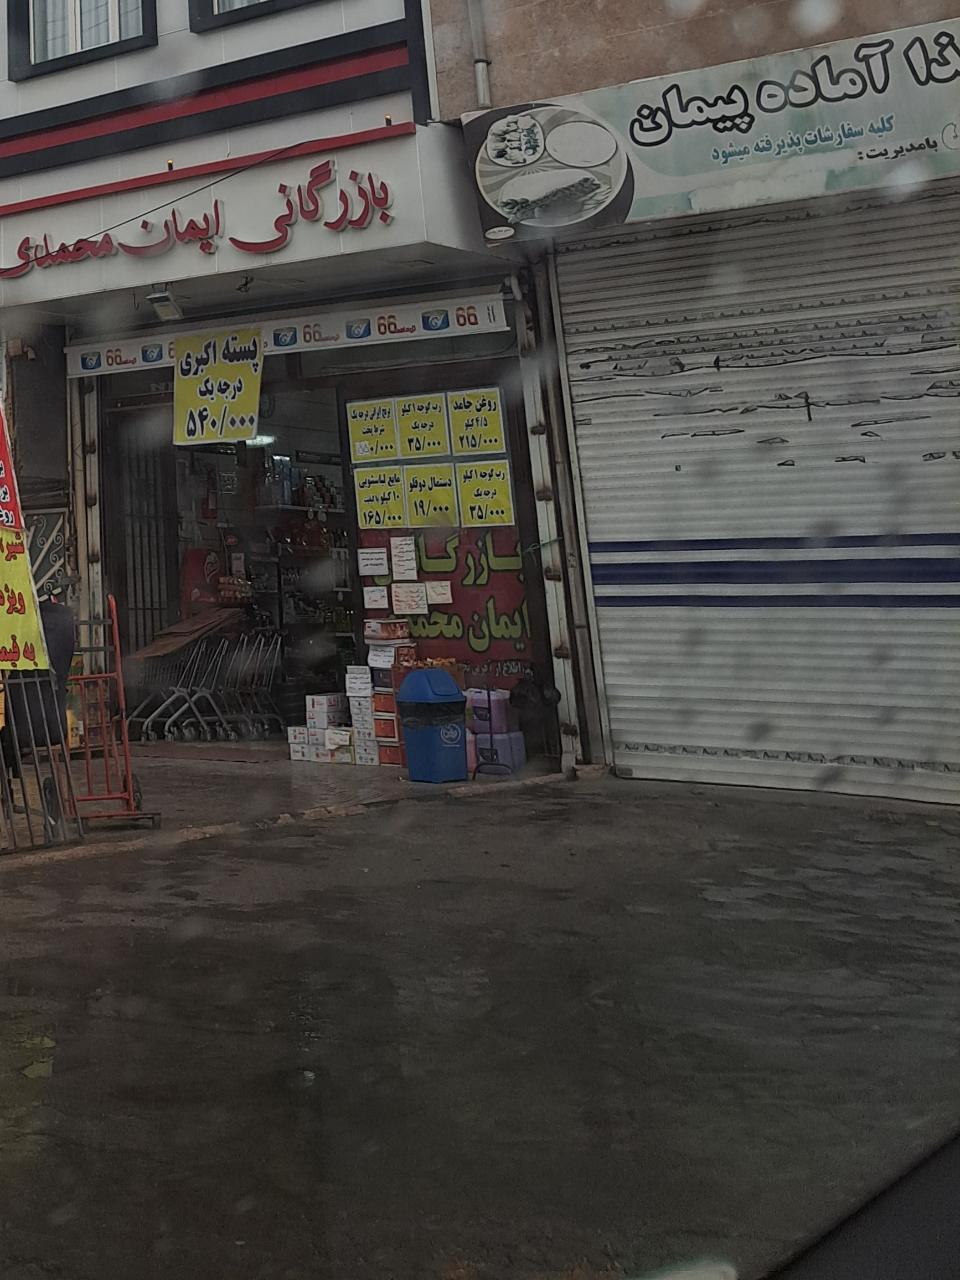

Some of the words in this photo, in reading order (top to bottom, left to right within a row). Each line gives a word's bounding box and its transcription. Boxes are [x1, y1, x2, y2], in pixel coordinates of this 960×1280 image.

[903, 31, 960, 87] ذا
[757, 39, 894, 112] آماده
[630, 84, 754, 147] پیمان
[867, 113, 896, 141] کلیه
[753, 130, 804, 159] پذیرفته
[804, 122, 864, 152] سفارشات
[711, 140, 751, 167] میشود
[228, 159, 393, 254] بازرگانی
[117, 199, 223, 257] ایمان
[377, 315, 397, 335] 66
[456, 306, 479, 326] 66
[303, 323, 321, 343] 66
[106, 348, 122, 366] 66
[180, 339, 217, 377] اکبری
[222, 336, 258, 372] پسته
[198, 376, 215, 401] یک
[217, 377, 243, 400] درجه
[417, 401, 431, 414] گوجه
[452, 398, 473, 413] جامد
[475, 395, 497, 412] روغن
[186, 405, 255, 437] ۵۴۰/۰۰۰
[465, 418, 475, 431] کیلو
[407, 436, 441, 452] ۳۵/۰۰۰
[458, 434, 498, 448] ۲۱۵/۰۰۰
[427, 475, 452, 491] دستمال
[479, 468, 494, 481] گوجه
[363, 509, 402, 525] ۱۶۵/۰۰۰
[413, 498, 450, 518] ۱۹/۰۰۰
[469, 503, 505, 520] ۳۵/۰۰۰
[468, 596, 531, 652] ایمان
[21, 638, 38, 664] به
